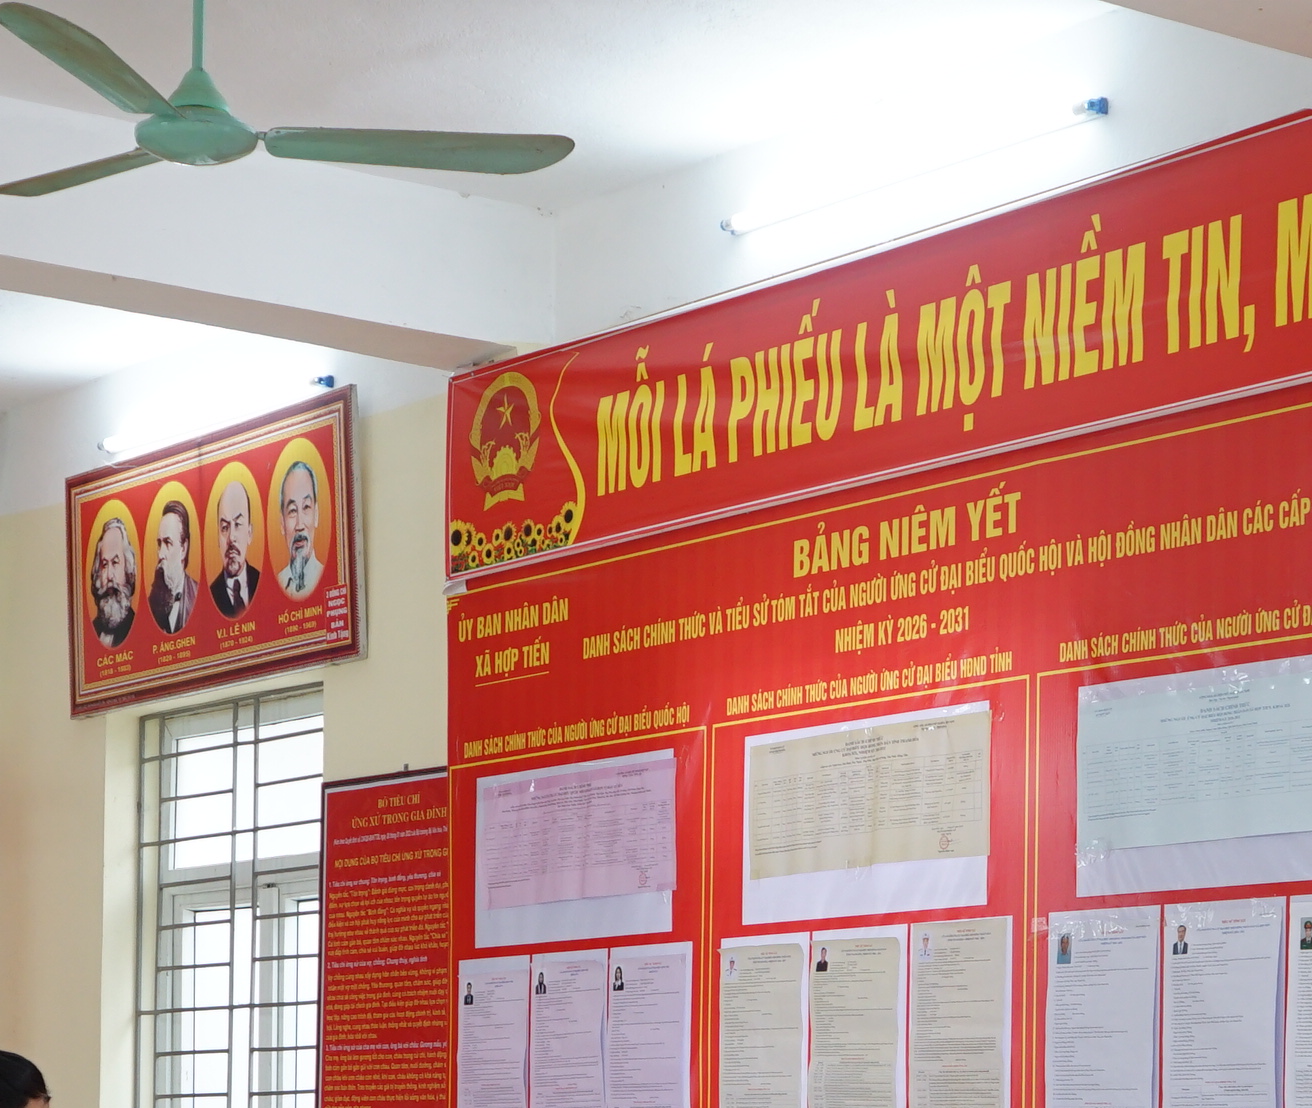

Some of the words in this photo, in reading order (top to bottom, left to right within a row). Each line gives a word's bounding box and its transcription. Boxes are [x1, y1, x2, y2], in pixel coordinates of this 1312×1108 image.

[597, 344, 664, 498] MỖI
[672, 342, 717, 478] LÁ
[728, 299, 842, 464] PHIẾU
[854, 290, 904, 429] LÀ
[916, 264, 1011, 431] MỘT
[1023, 213, 1146, 389] NIỀM
[1160, 214, 1255, 355] TIN,
[793, 522, 869, 578] BẢNG
[879, 504, 956, 560] NIÊM
[966, 481, 1021, 541] YẾT
[582, 632, 610, 659] DANH
[613, 626, 640, 654] SÁCH
[644, 618, 676, 648] CHÍNH
[678, 611, 706, 640] THỨC
[709, 606, 723, 635] VÀ
[726, 596, 750, 632] TIỂU
[753, 594, 769, 626] SỬ
[771, 592, 796, 622] TÓM
[799, 584, 819, 617] TẮT
[822, 580, 846, 612] CỦA
[850, 573, 887, 608] NGƯỜI
[891, 570, 916, 601] ỨNG
[920, 560, 938, 595] CỬ
[940, 562, 961, 594] ĐẠI
[966, 547, 996, 586] BIỂU
[999, 540, 1035, 582] QUỐC
[1039, 539, 1061, 575] HỘI
[1066, 534, 1084, 567] VÀ
[1088, 529, 1111, 567] HỘI
[1116, 521, 1155, 558] ĐỒNG
[1160, 514, 1202, 551] NHÂN
[1206, 507, 1238, 542] DÂN
[1243, 500, 1274, 535] CÁC
[1279, 488, 1310, 529] CẤP
[458, 613, 473, 642] ỦY
[477, 612, 501, 638] BAN
[505, 602, 539, 633] NHÂN
[543, 596, 568, 625] DÂN
[835, 620, 874, 655] NHIỆM
[878, 614, 894, 645] KỲ
[897, 618, 927, 643] 2026
[940, 606, 970, 635] 2031
[1059, 638, 1087, 663] DANH
[1090, 632, 1119, 657] SÁCH
[1122, 625, 1156, 653] CHÍNH
[1159, 622, 1188, 648] THỨC
[1191, 614, 1213, 643] CỦA
[1217, 611, 1252, 640] NGƯỜI
[1256, 608, 1280, 633] ỨNG
[1283, 600, 1301, 630] CỬ
[96, 655, 114, 667] CÁC
[116, 651, 134, 663] MÁC
[475, 650, 491, 678] XÃ
[495, 647, 519, 677] HỢP
[522, 636, 549, 668] TIẾN
